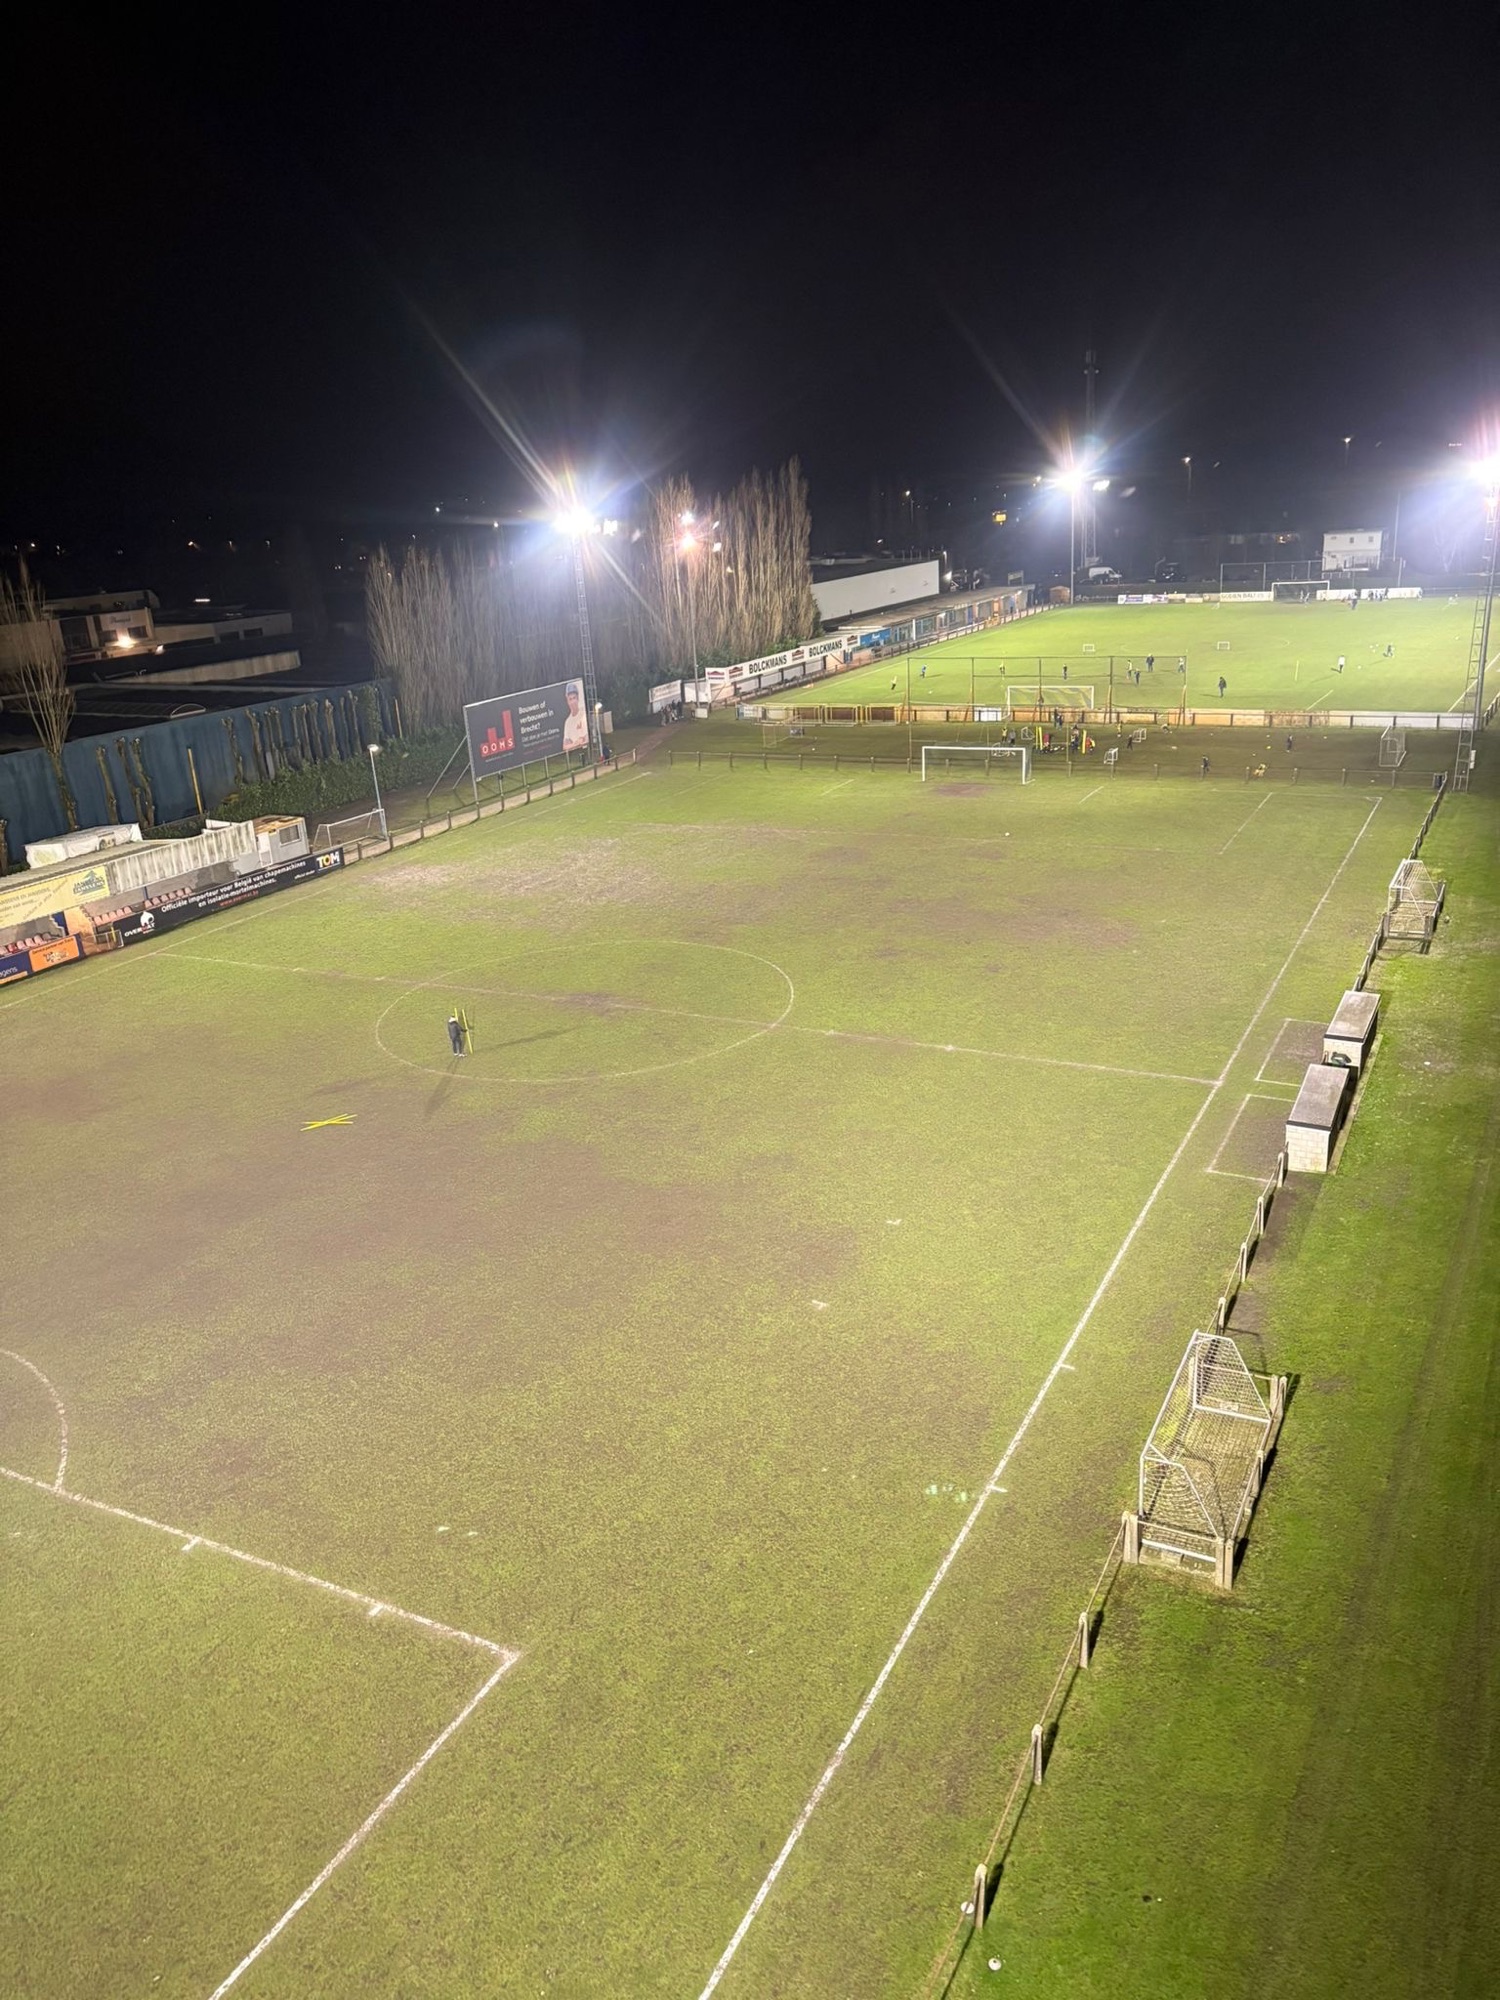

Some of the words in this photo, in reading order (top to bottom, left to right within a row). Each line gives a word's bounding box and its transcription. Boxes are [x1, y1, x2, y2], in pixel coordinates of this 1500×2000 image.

[808, 640, 842, 657] BOLCKMANS
[749, 655, 787, 674] BOLCKMANS
[519, 704, 539, 714] Bouwen
[540, 700, 546, 709] of
[520, 711, 548, 724] verbouwen
[548, 709, 554, 717] in
[521, 722, 540, 734] Brecht?
[481, 737, 514, 754] OOMS
[316, 851, 340, 868] TOM
[161, 900, 188, 912] Officiële
[188, 889, 219, 903] importeur
[219, 884, 233, 894] voor
[234, 876, 252, 888] België
[252, 873, 264, 882] van
[264, 860, 306, 878] chapemachines
[198, 900, 207, 908] en
